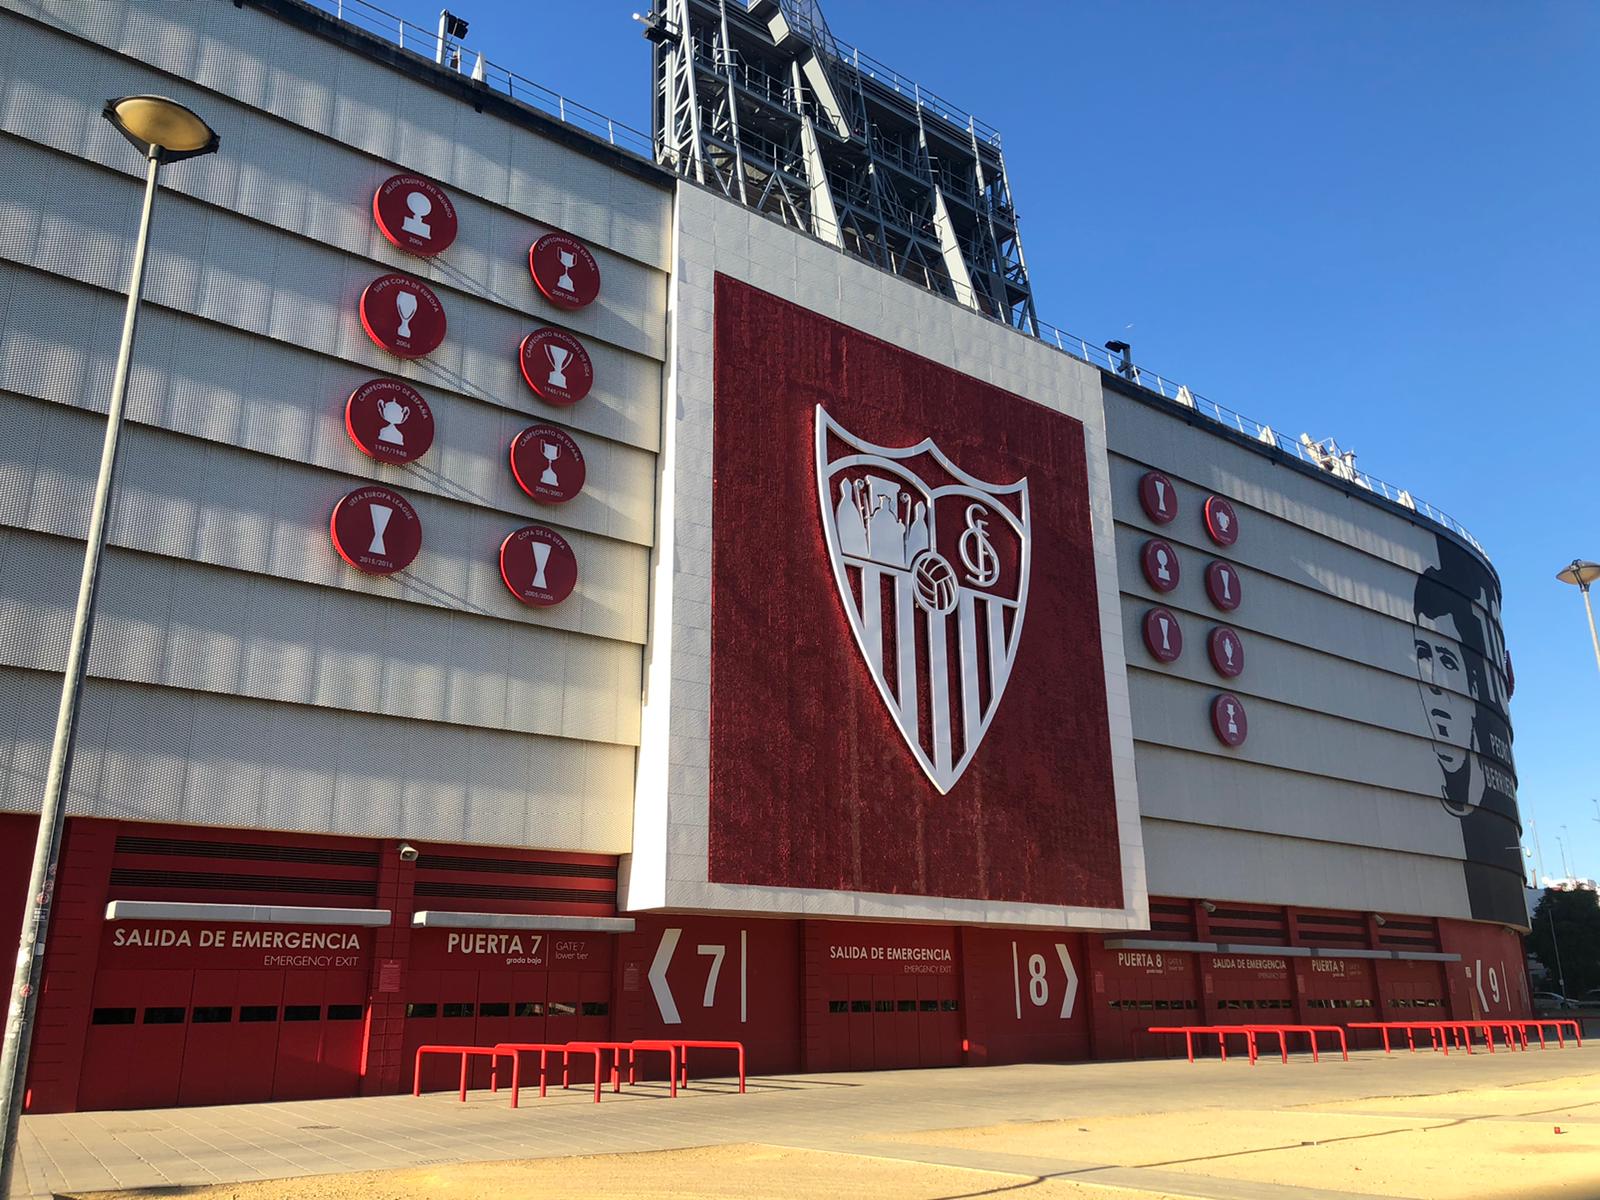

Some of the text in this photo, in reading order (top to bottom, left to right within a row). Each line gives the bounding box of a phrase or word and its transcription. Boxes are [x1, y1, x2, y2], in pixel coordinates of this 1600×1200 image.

[384, 178, 453, 219] MEJOR EQUIPO DEL MUNDO
[409, 236, 423, 246] 2006
[538, 237, 573, 251] CAMPEONATO
[373, 280, 390, 293] SUPER
[411, 282, 420, 290] DE
[420, 288, 439, 313] EUROPA
[396, 339, 411, 349] 2006
[526, 331, 552, 358] CAMPEONATO
[358, 383, 401, 402] CAMPEONATO
[402, 389, 411, 397] DE
[544, 386, 571, 399] 1945/1946
[520, 429, 556, 447] CAMPEONATO
[375, 444, 407, 458] 1947/1948
[348, 491, 413, 520] UEFA EUROPA LEAGUE
[518, 530, 535, 541] COPA
[544, 531, 552, 539] LA
[552, 536, 566, 551] UEFA
[360, 555, 393, 568] 2015/2016
[113, 928, 360, 950] SALIDA DE EMERGENCIA
[447, 933, 543, 954] PUERTA 7
[555, 941, 586, 951] GATE 7
[264, 955, 360, 967] EMERGENCY EXIT
[506, 957, 542, 965] grada baja
[555, 952, 589, 960] lower tier
[830, 945, 952, 961] SALIDA DE EMERGENCIA
[1118, 952, 1154, 967] PUERTA
[1156, 953, 1163, 968] 8
[904, 965, 952, 974] EMERGENCY EXIT
[1212, 958, 1287, 970] SALIDA DE EMERGENCIA
[1312, 959, 1339, 972] PUERTA
[1340, 960, 1345, 973] 9
[697, 944, 726, 1007] 7
[1028, 953, 1049, 1007] 8
[1488, 967, 1500, 1004] 9
